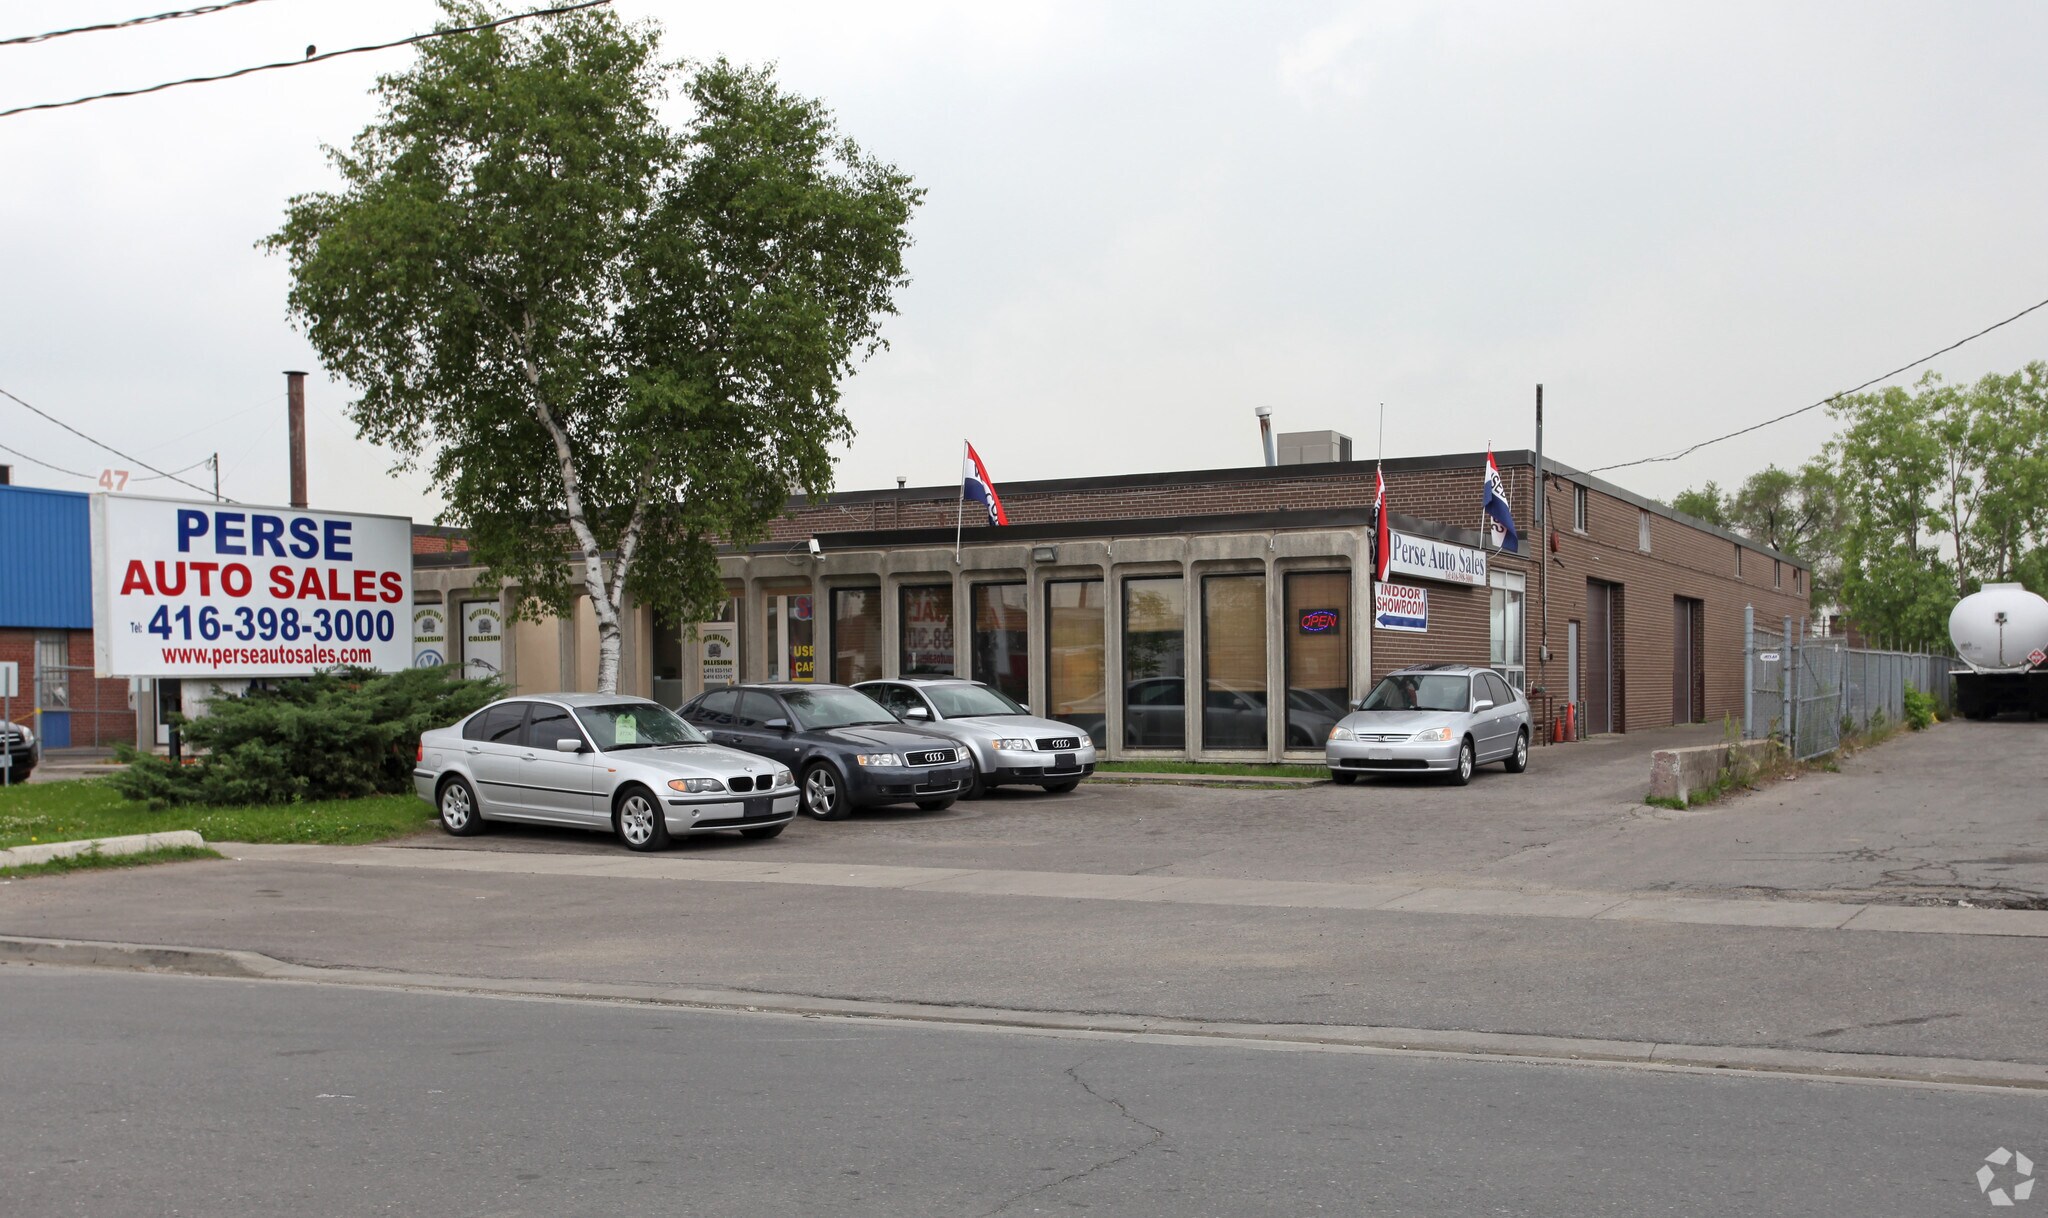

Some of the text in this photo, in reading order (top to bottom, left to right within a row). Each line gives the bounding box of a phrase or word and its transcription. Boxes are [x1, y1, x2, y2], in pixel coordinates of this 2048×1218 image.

[98, 468, 130, 492] 47
[177, 509, 353, 562] PERSE
[1392, 533, 1485, 576] Perse Auto Sales
[120, 559, 404, 603] AUTO SALES
[1380, 583, 1421, 600] INDOOR
[1376, 596, 1424, 615] SHOWROOM
[130, 604, 395, 642] Tel: 416-398-3000
[1301, 614, 1338, 628] OPEN
[161, 643, 372, 669] www.perseautosales.com
